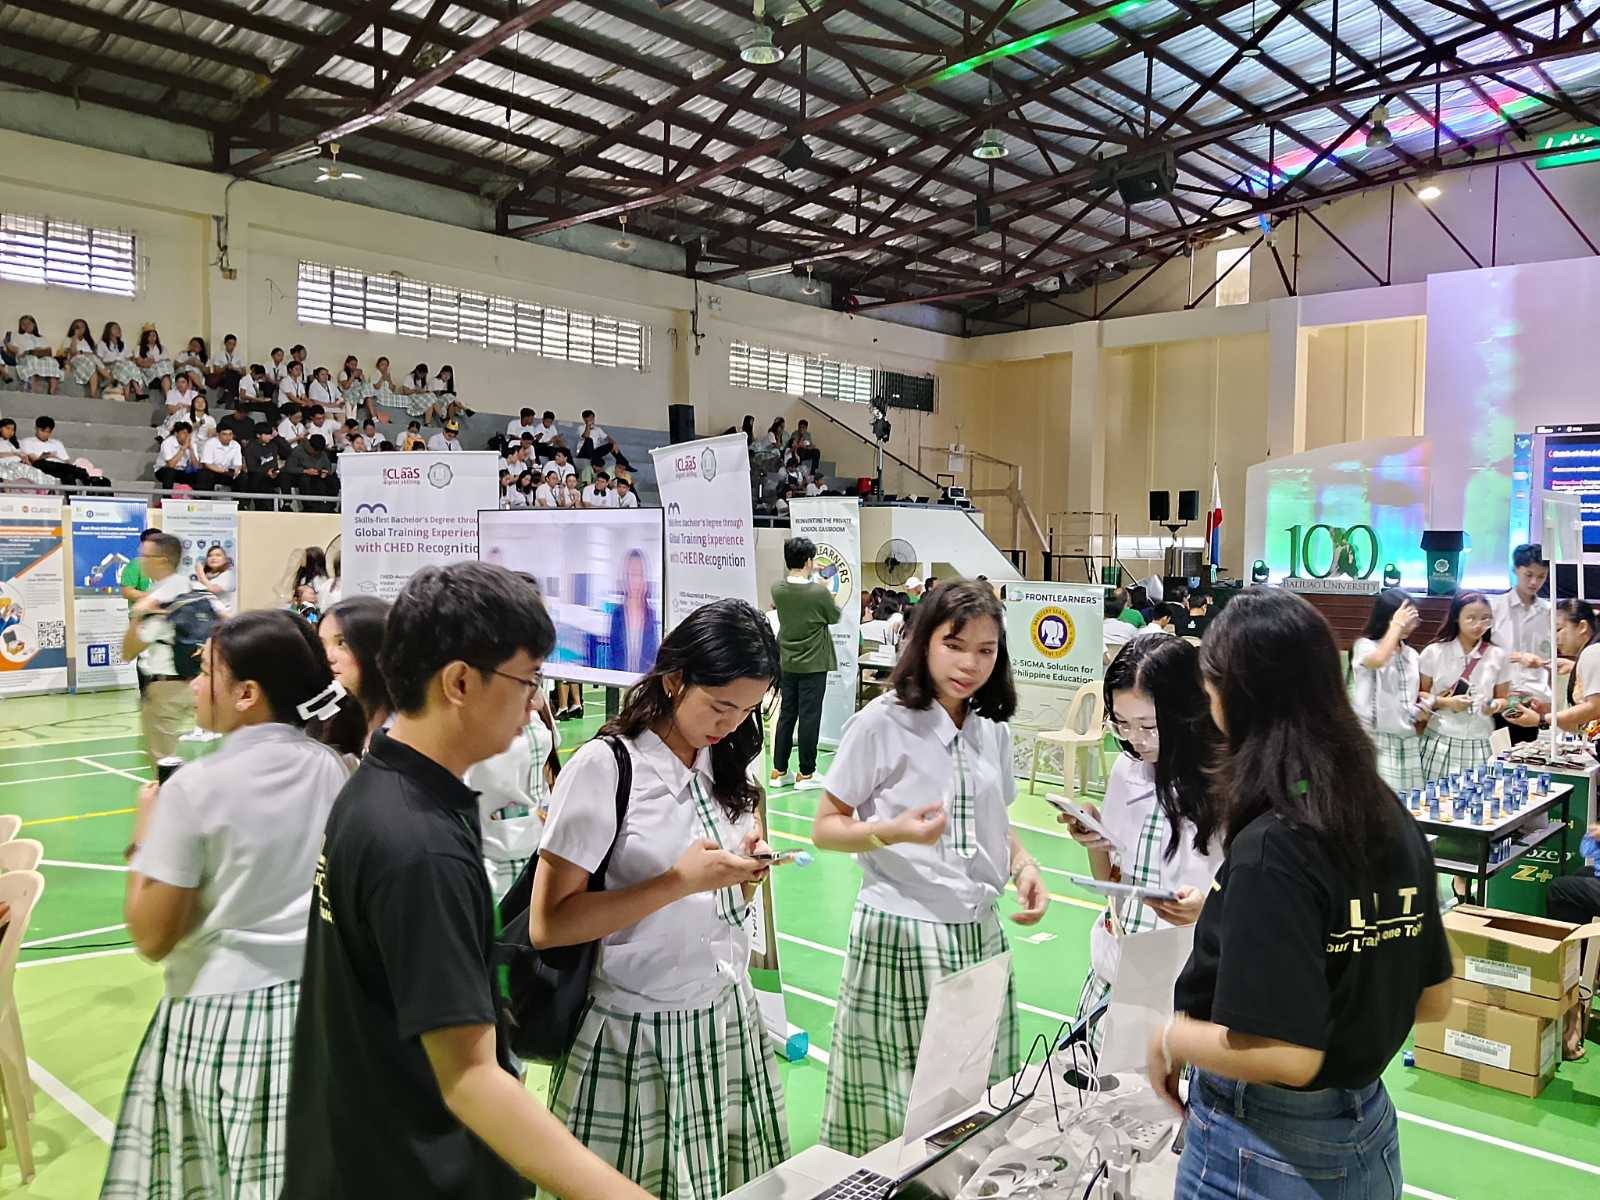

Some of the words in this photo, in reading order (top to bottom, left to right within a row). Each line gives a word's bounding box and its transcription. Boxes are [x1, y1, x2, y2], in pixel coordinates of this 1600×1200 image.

[390, 516, 429, 524] Bachelor's
[430, 516, 456, 525] Degree
[456, 516, 478, 524] throu
[355, 527, 387, 537] Global
[388, 527, 429, 539] Training
[431, 527, 478, 540] Experien
[355, 542, 382, 553] with
[384, 543, 414, 553] CHED
[417, 542, 478, 556] Recognitio
[1284, 524, 1379, 580] 100
[698, 552, 746, 570] Recognition
[1025, 593, 1097, 605] FRONTLEARNERS
[1046, 662, 1080, 672] Solution
[1081, 665, 1094, 674] for
[1052, 673, 1094, 684] Education
[1510, 864, 1554, 883] Z+
[1326, 941, 1350, 952] our
